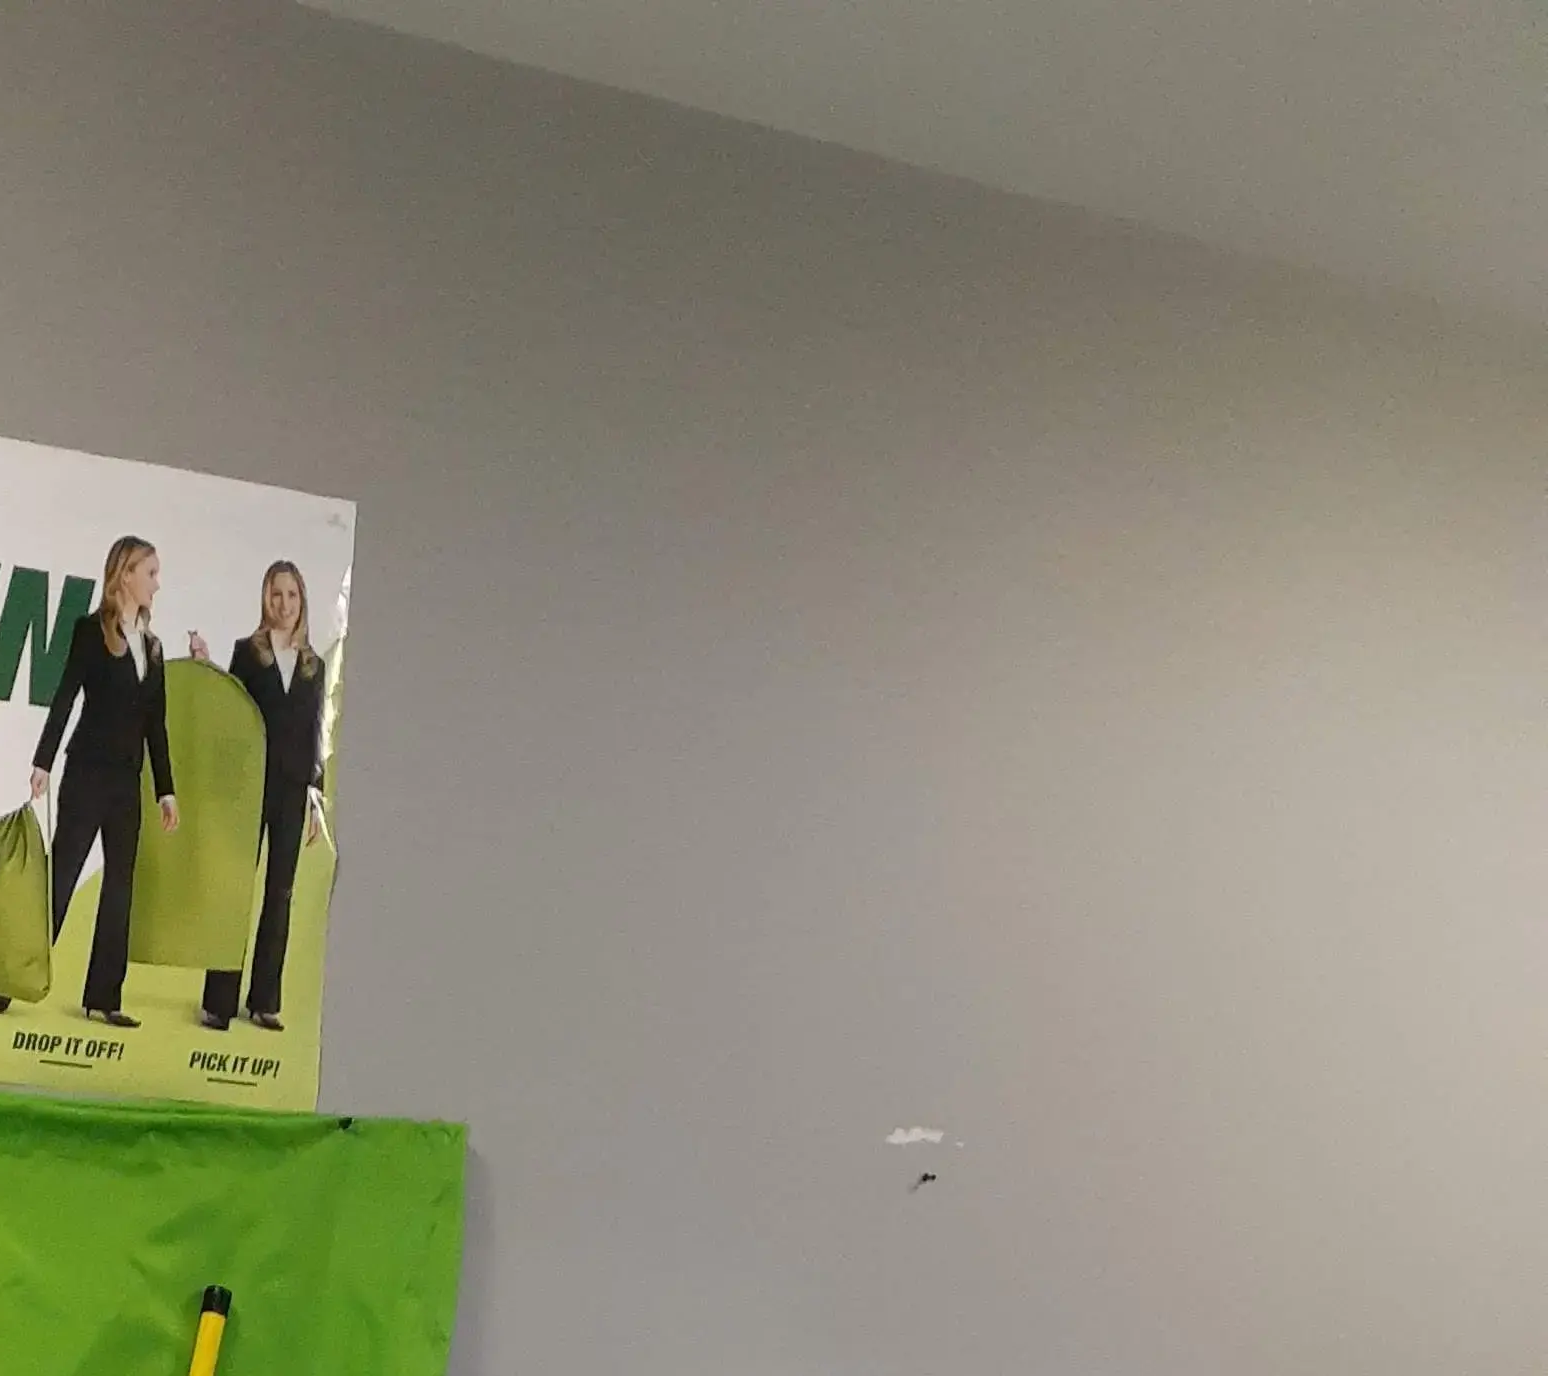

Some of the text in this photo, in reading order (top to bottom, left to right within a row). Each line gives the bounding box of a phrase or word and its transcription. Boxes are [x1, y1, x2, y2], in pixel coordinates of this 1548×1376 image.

[12, 1031, 125, 1062] DROP IT OFF!
[188, 1050, 281, 1079] PICK IT UP!
